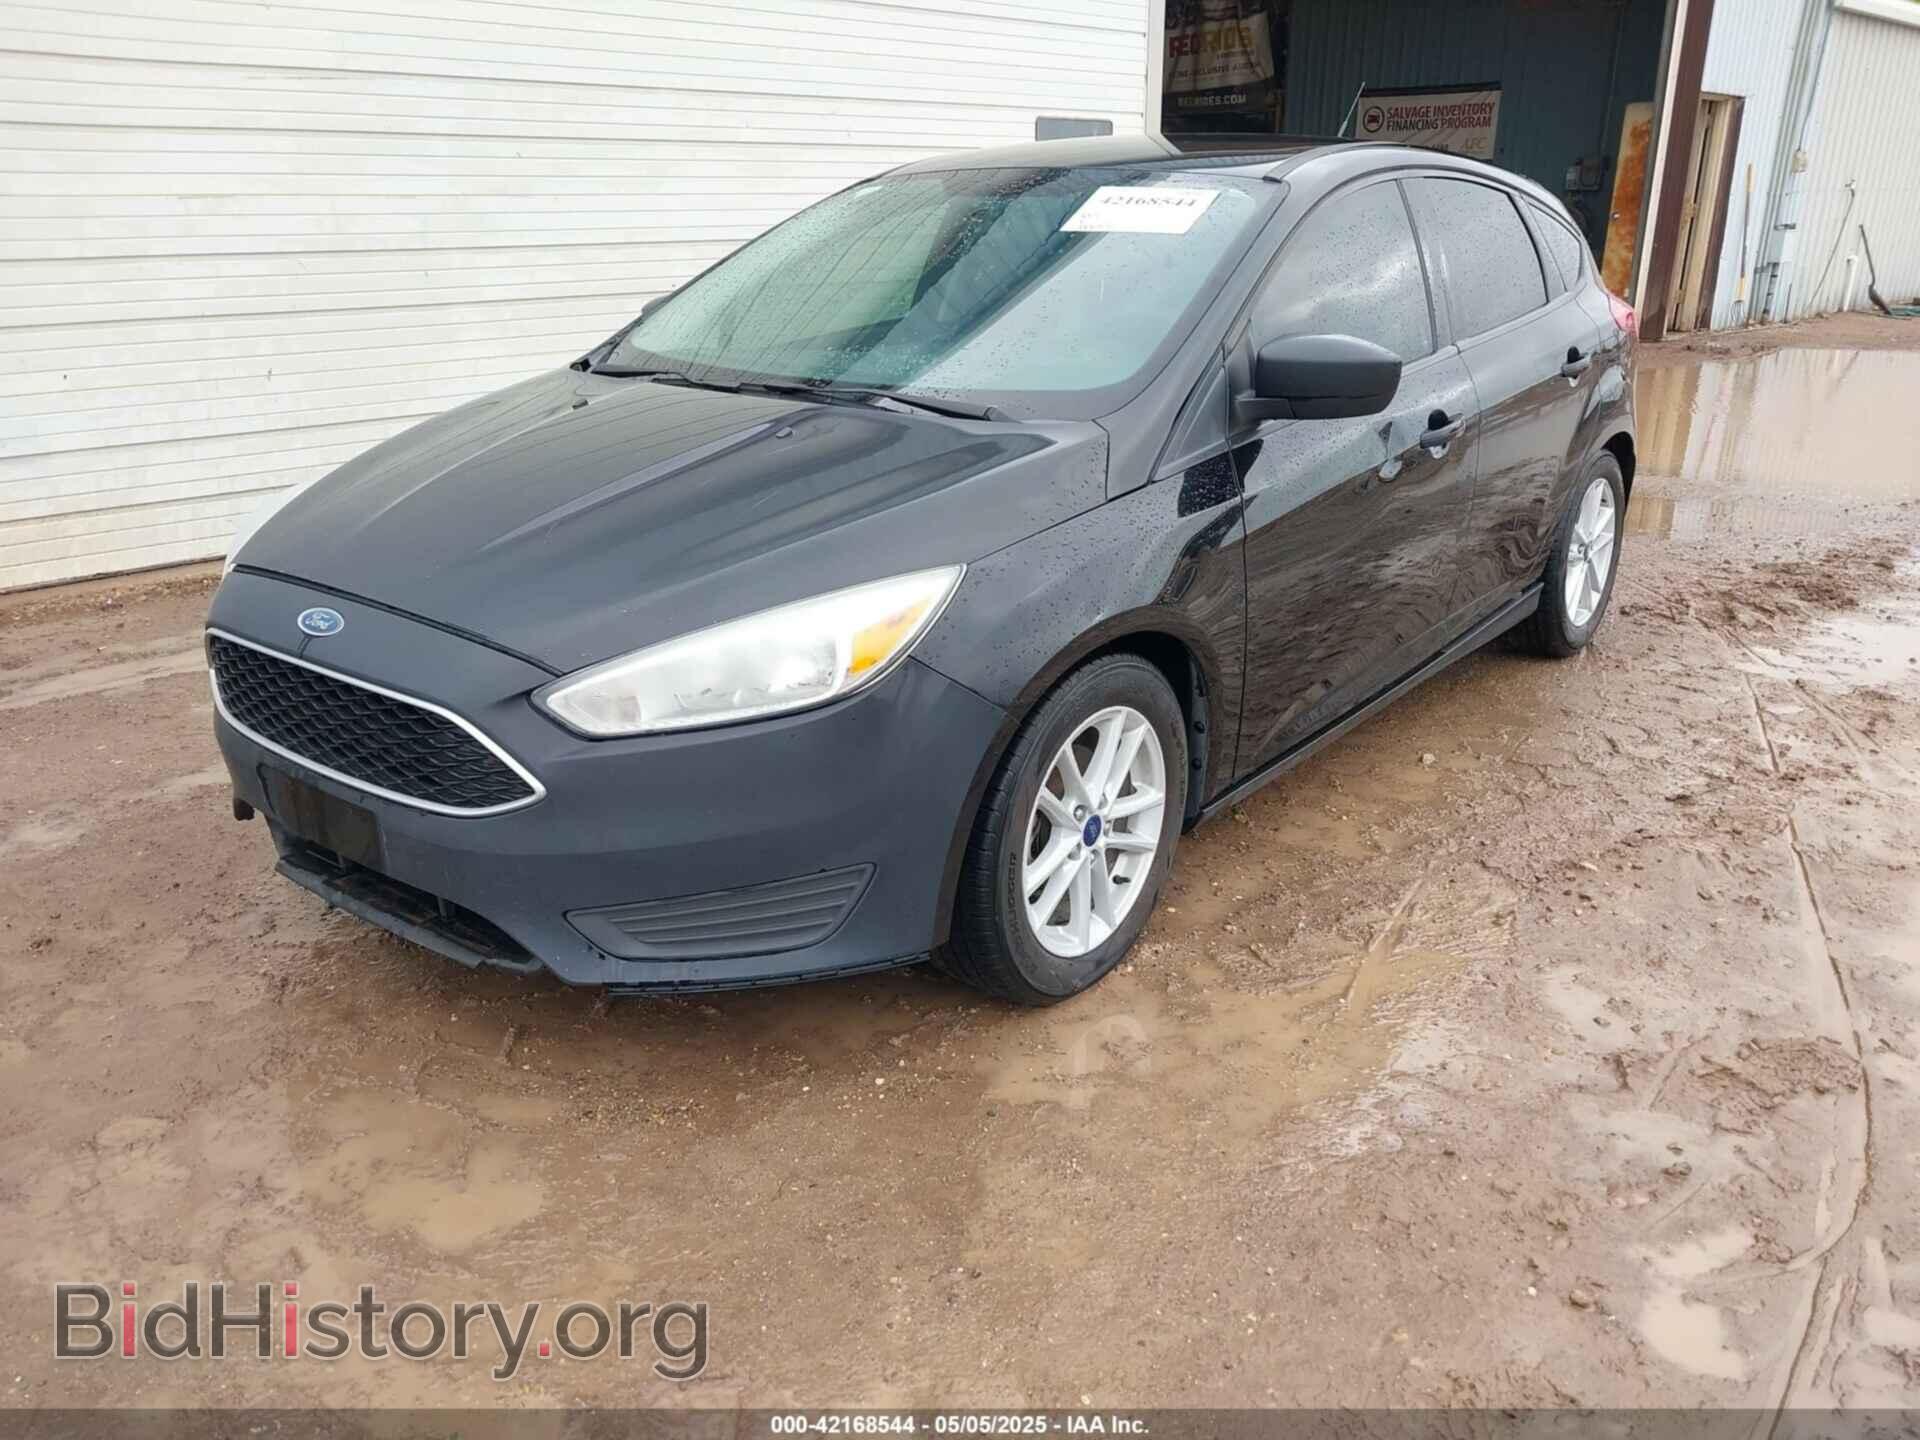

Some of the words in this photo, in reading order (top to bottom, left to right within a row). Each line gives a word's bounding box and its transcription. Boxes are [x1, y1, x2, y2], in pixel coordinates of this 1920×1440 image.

[1386, 105, 1432, 120] SALVAGE
[1433, 102, 1495, 117] INVENTORY
[1386, 117, 1438, 131] FINANCING
[1440, 115, 1491, 129] PROGRAM
